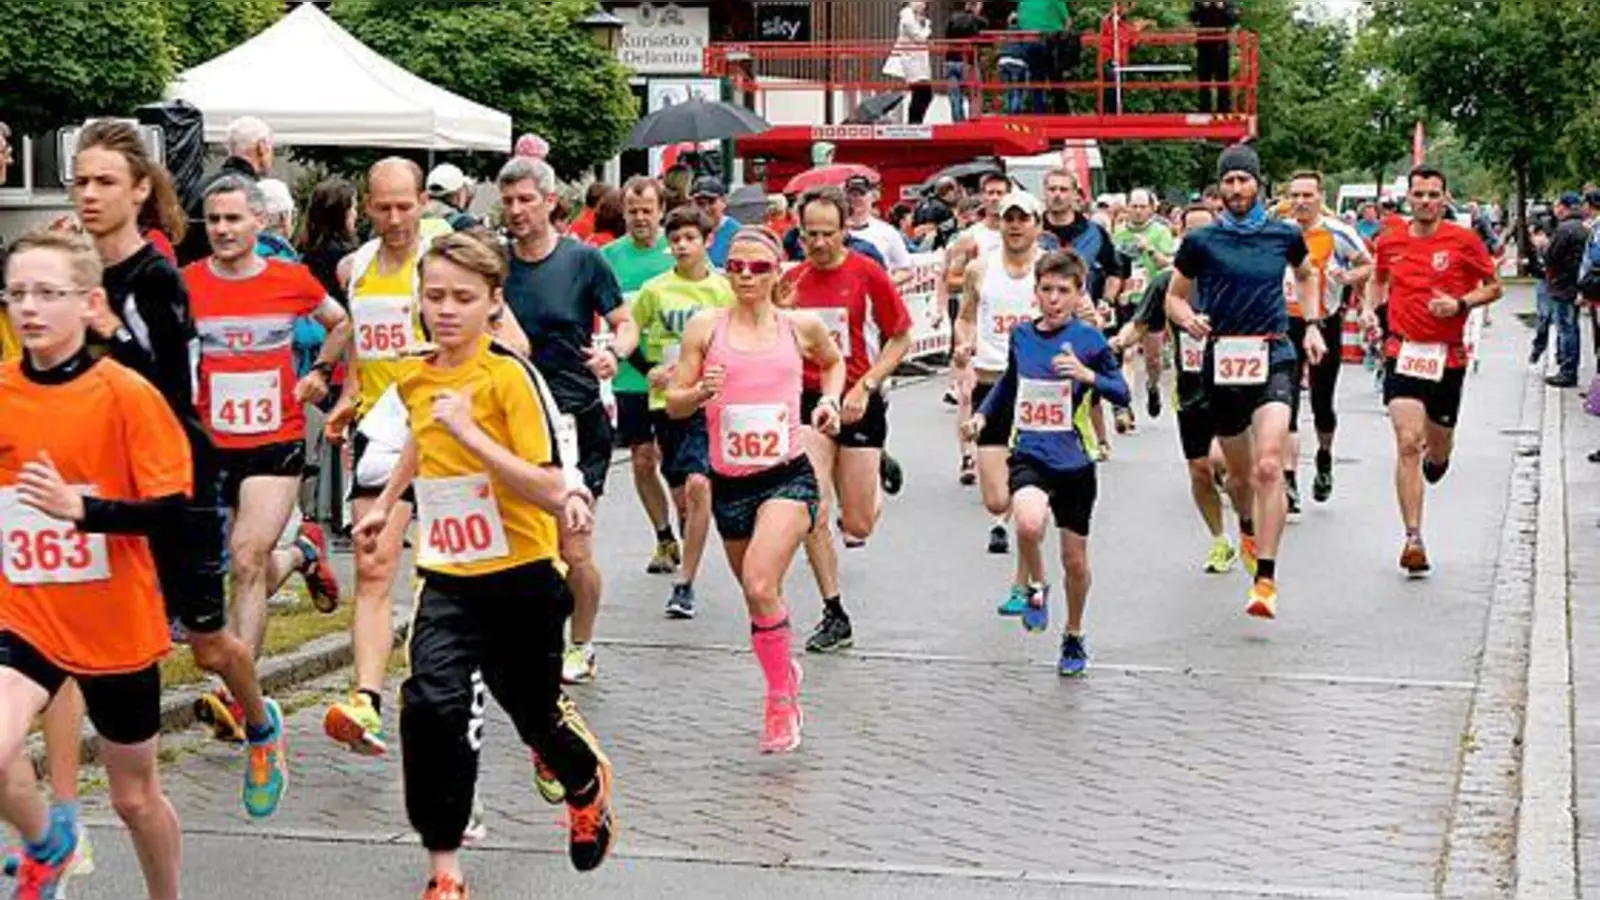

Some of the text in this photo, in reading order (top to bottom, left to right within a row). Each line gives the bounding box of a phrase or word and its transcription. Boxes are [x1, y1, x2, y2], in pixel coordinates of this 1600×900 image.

[762, 16, 801, 40] sky
[359, 323, 407, 351] 365
[1219, 357, 1262, 379] 372
[219, 398, 273, 425] 413
[1020, 401, 1065, 425] 345
[727, 431, 780, 458] 362
[428, 513, 492, 554] 400
[9, 529, 92, 571] 363
